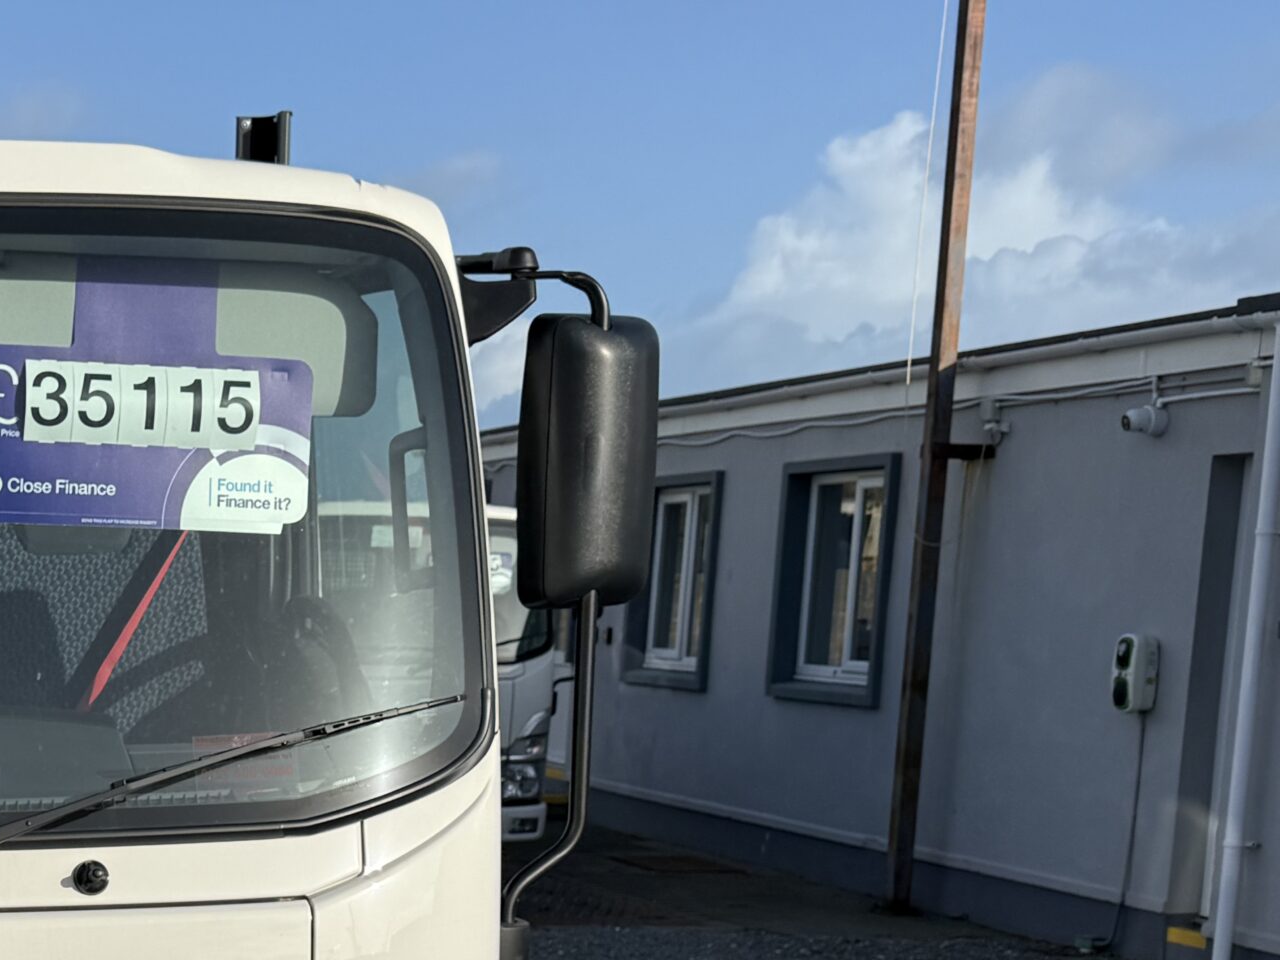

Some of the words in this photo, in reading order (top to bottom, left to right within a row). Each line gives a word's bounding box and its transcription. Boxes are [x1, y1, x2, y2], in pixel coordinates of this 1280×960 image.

[1, 429, 20, 438] Price
[7, 477, 52, 494] Close
[55, 479, 116, 496] Finance
[217, 478, 261, 493] Found
[263, 480, 273, 494] it
[217, 494, 271, 510] Finance
[273, 496, 291, 511] it?
